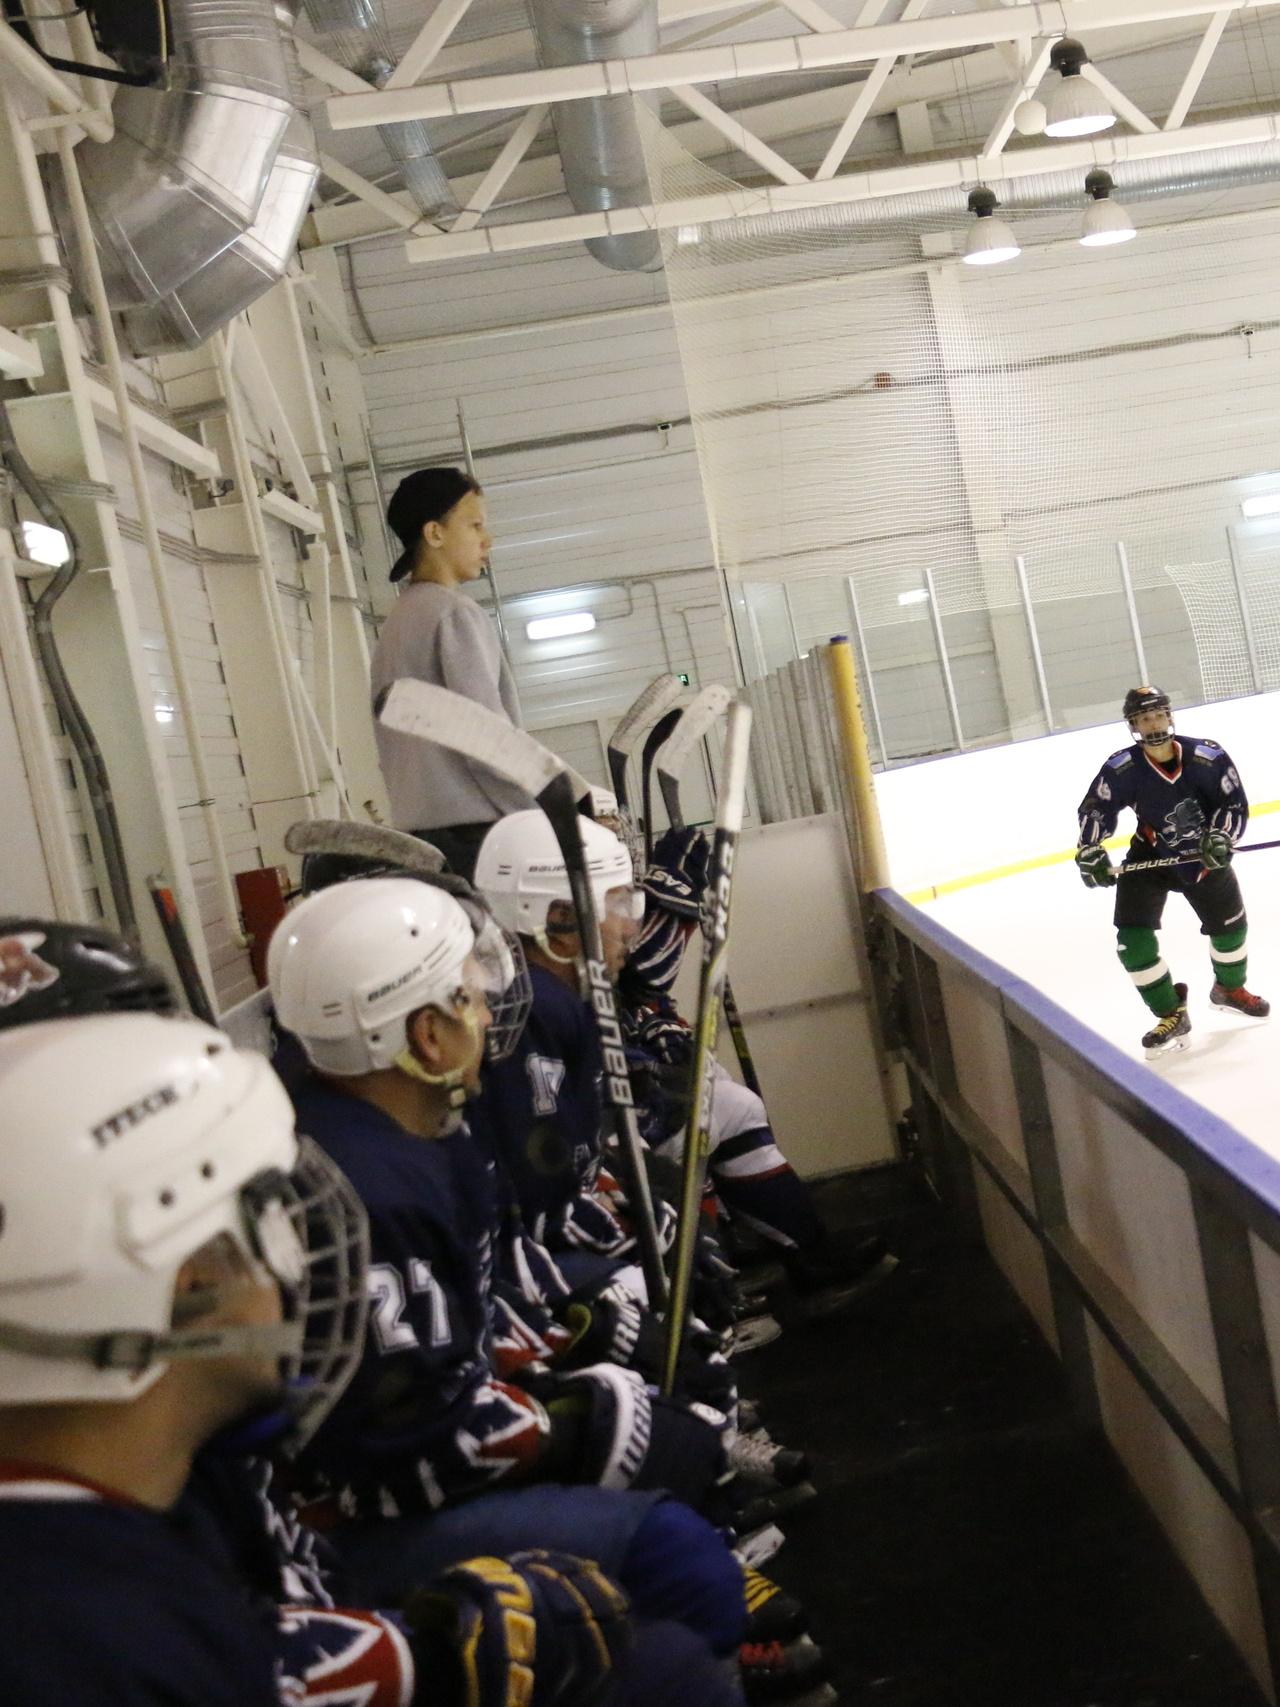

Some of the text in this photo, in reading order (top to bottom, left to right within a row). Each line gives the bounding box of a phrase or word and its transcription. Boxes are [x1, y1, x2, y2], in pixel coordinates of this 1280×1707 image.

[367, 963, 424, 1003] BAUER
[588, 958, 635, 1108] BAUER
[363, 1256, 453, 1355] 21
